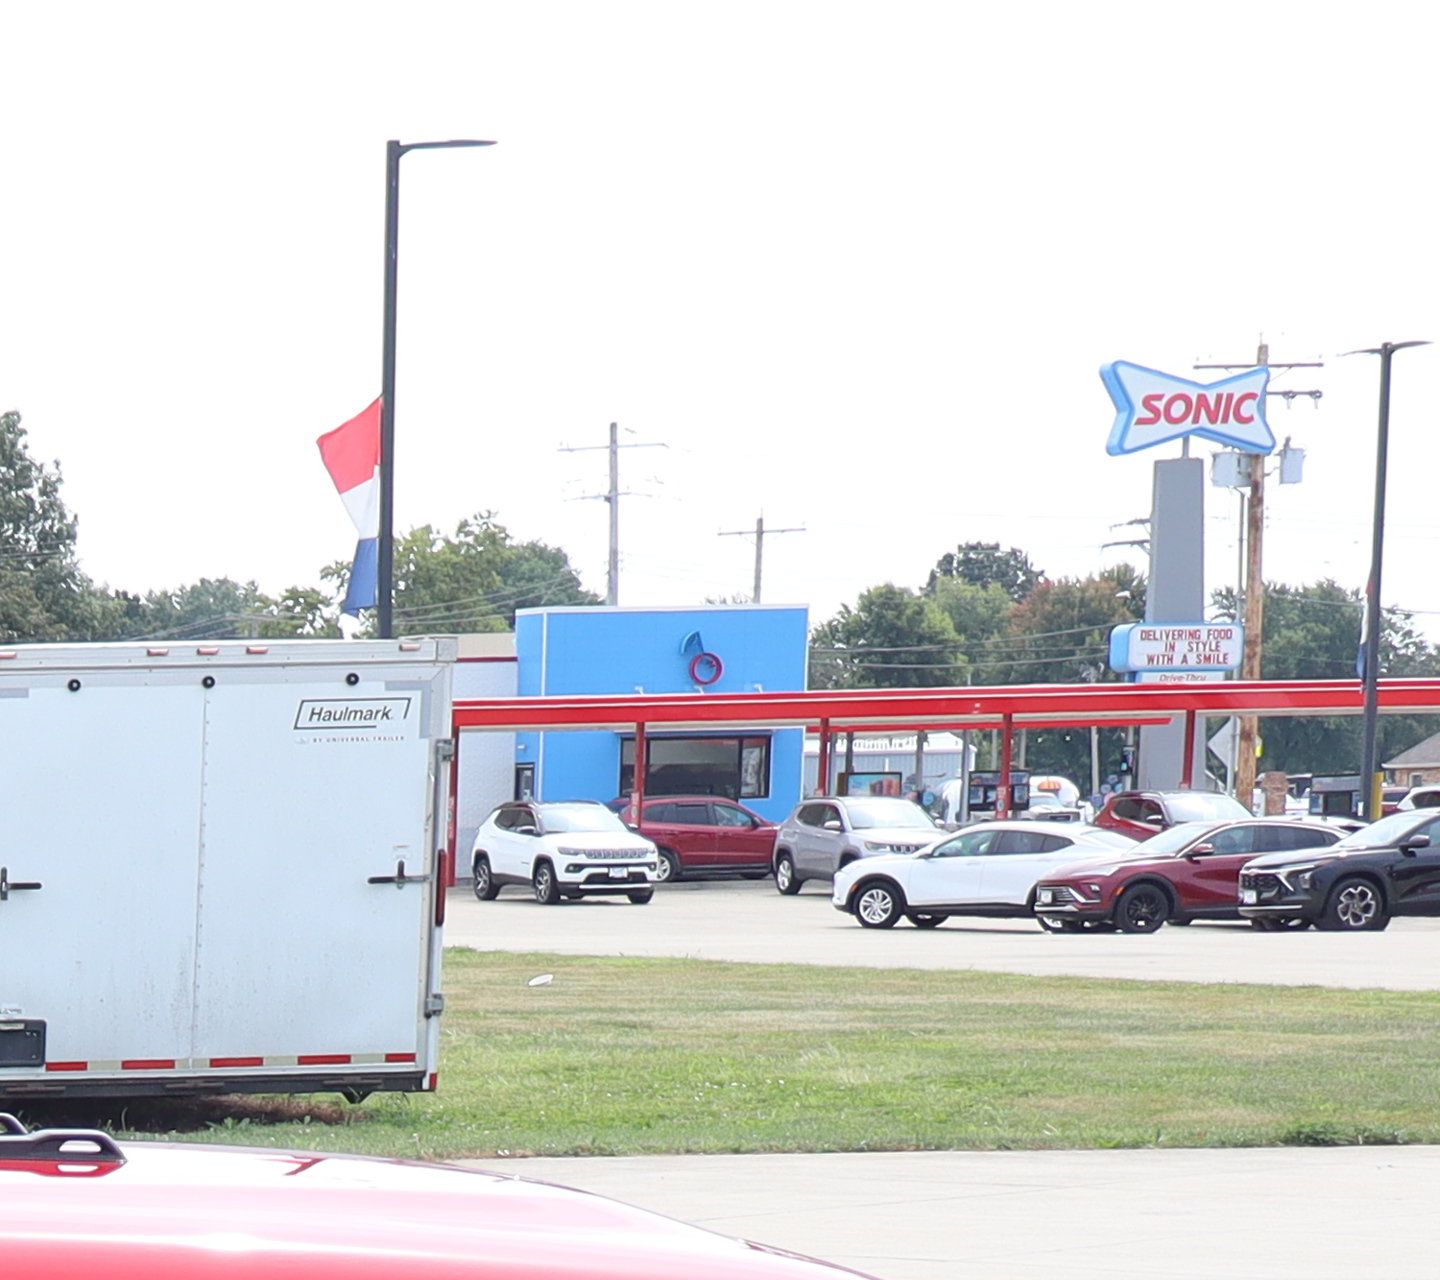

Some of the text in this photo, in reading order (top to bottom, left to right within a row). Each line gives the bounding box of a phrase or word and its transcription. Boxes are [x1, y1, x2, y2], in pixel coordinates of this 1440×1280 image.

[1134, 392, 1259, 426] SONIC
[1140, 628, 1233, 641] DELIVERING FOOD
[1164, 640, 1221, 652] IN STYLE
[1146, 653, 1229, 665] WITH A SMILE
[308, 705, 392, 722] Haulmark
